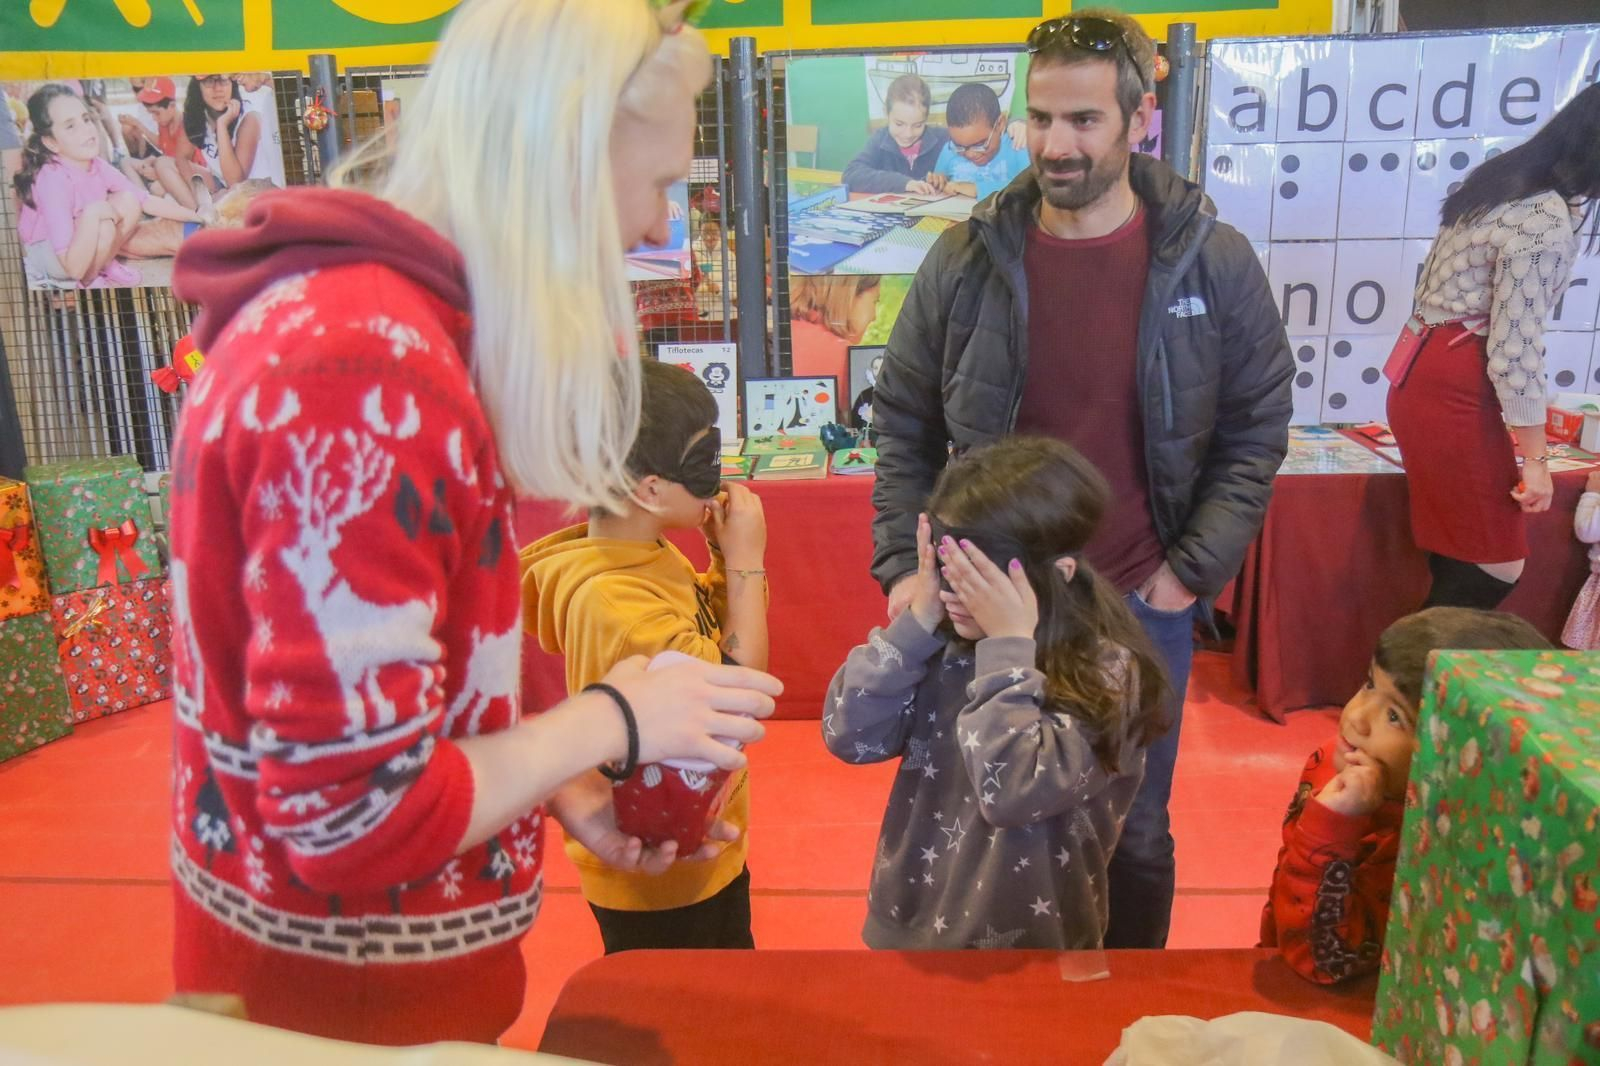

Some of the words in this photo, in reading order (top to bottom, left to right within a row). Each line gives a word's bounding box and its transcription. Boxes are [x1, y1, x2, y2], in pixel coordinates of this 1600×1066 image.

[1228, 86, 1267, 132] a
[1297, 68, 1338, 132] b
[1369, 84, 1407, 131] c
[1432, 63, 1476, 129] d
[1499, 77, 1541, 126] e
[1282, 283, 1318, 326] n
[1347, 280, 1385, 325] o
